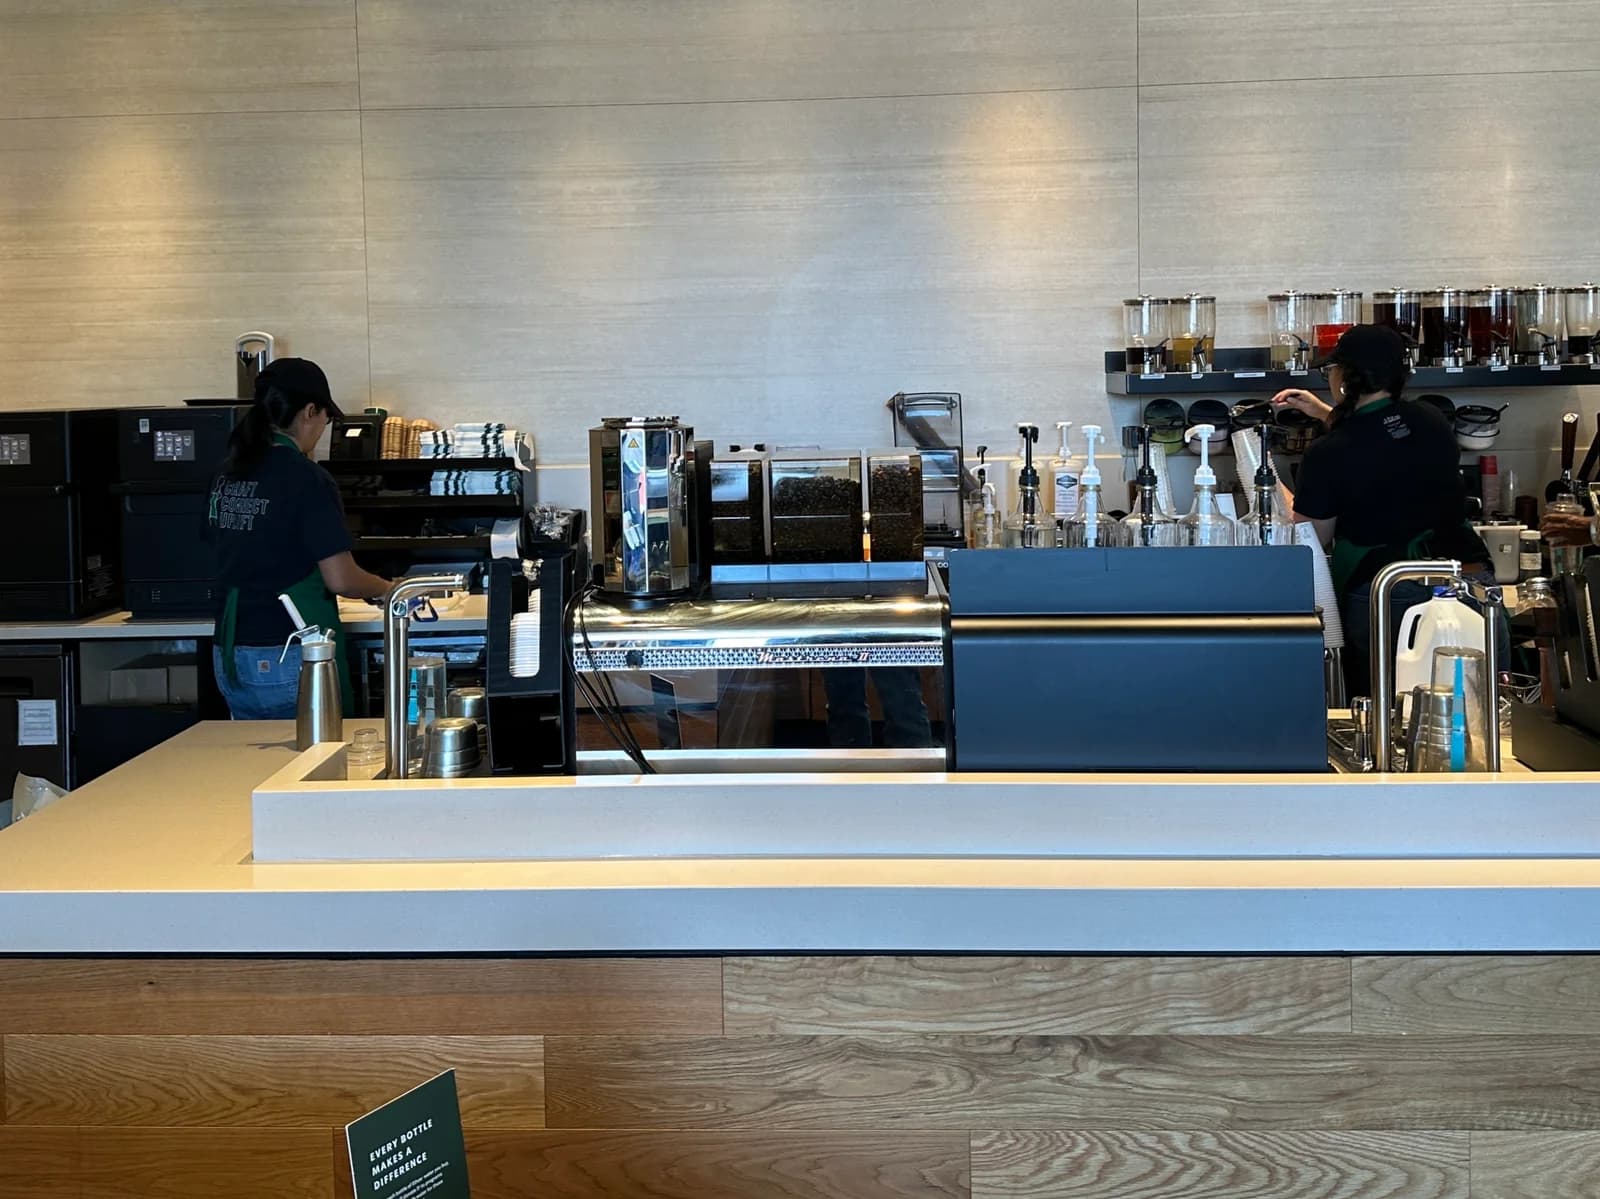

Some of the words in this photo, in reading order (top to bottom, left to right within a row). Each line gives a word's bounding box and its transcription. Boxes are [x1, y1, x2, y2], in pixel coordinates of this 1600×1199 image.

[370, 1138, 398, 1162] EVERY
[400, 1118, 433, 1144] BOTTLE
[371, 1151, 404, 1177] MAKES
[406, 1146, 413, 1156] A
[373, 1152, 428, 1191] DIFFERENCE
